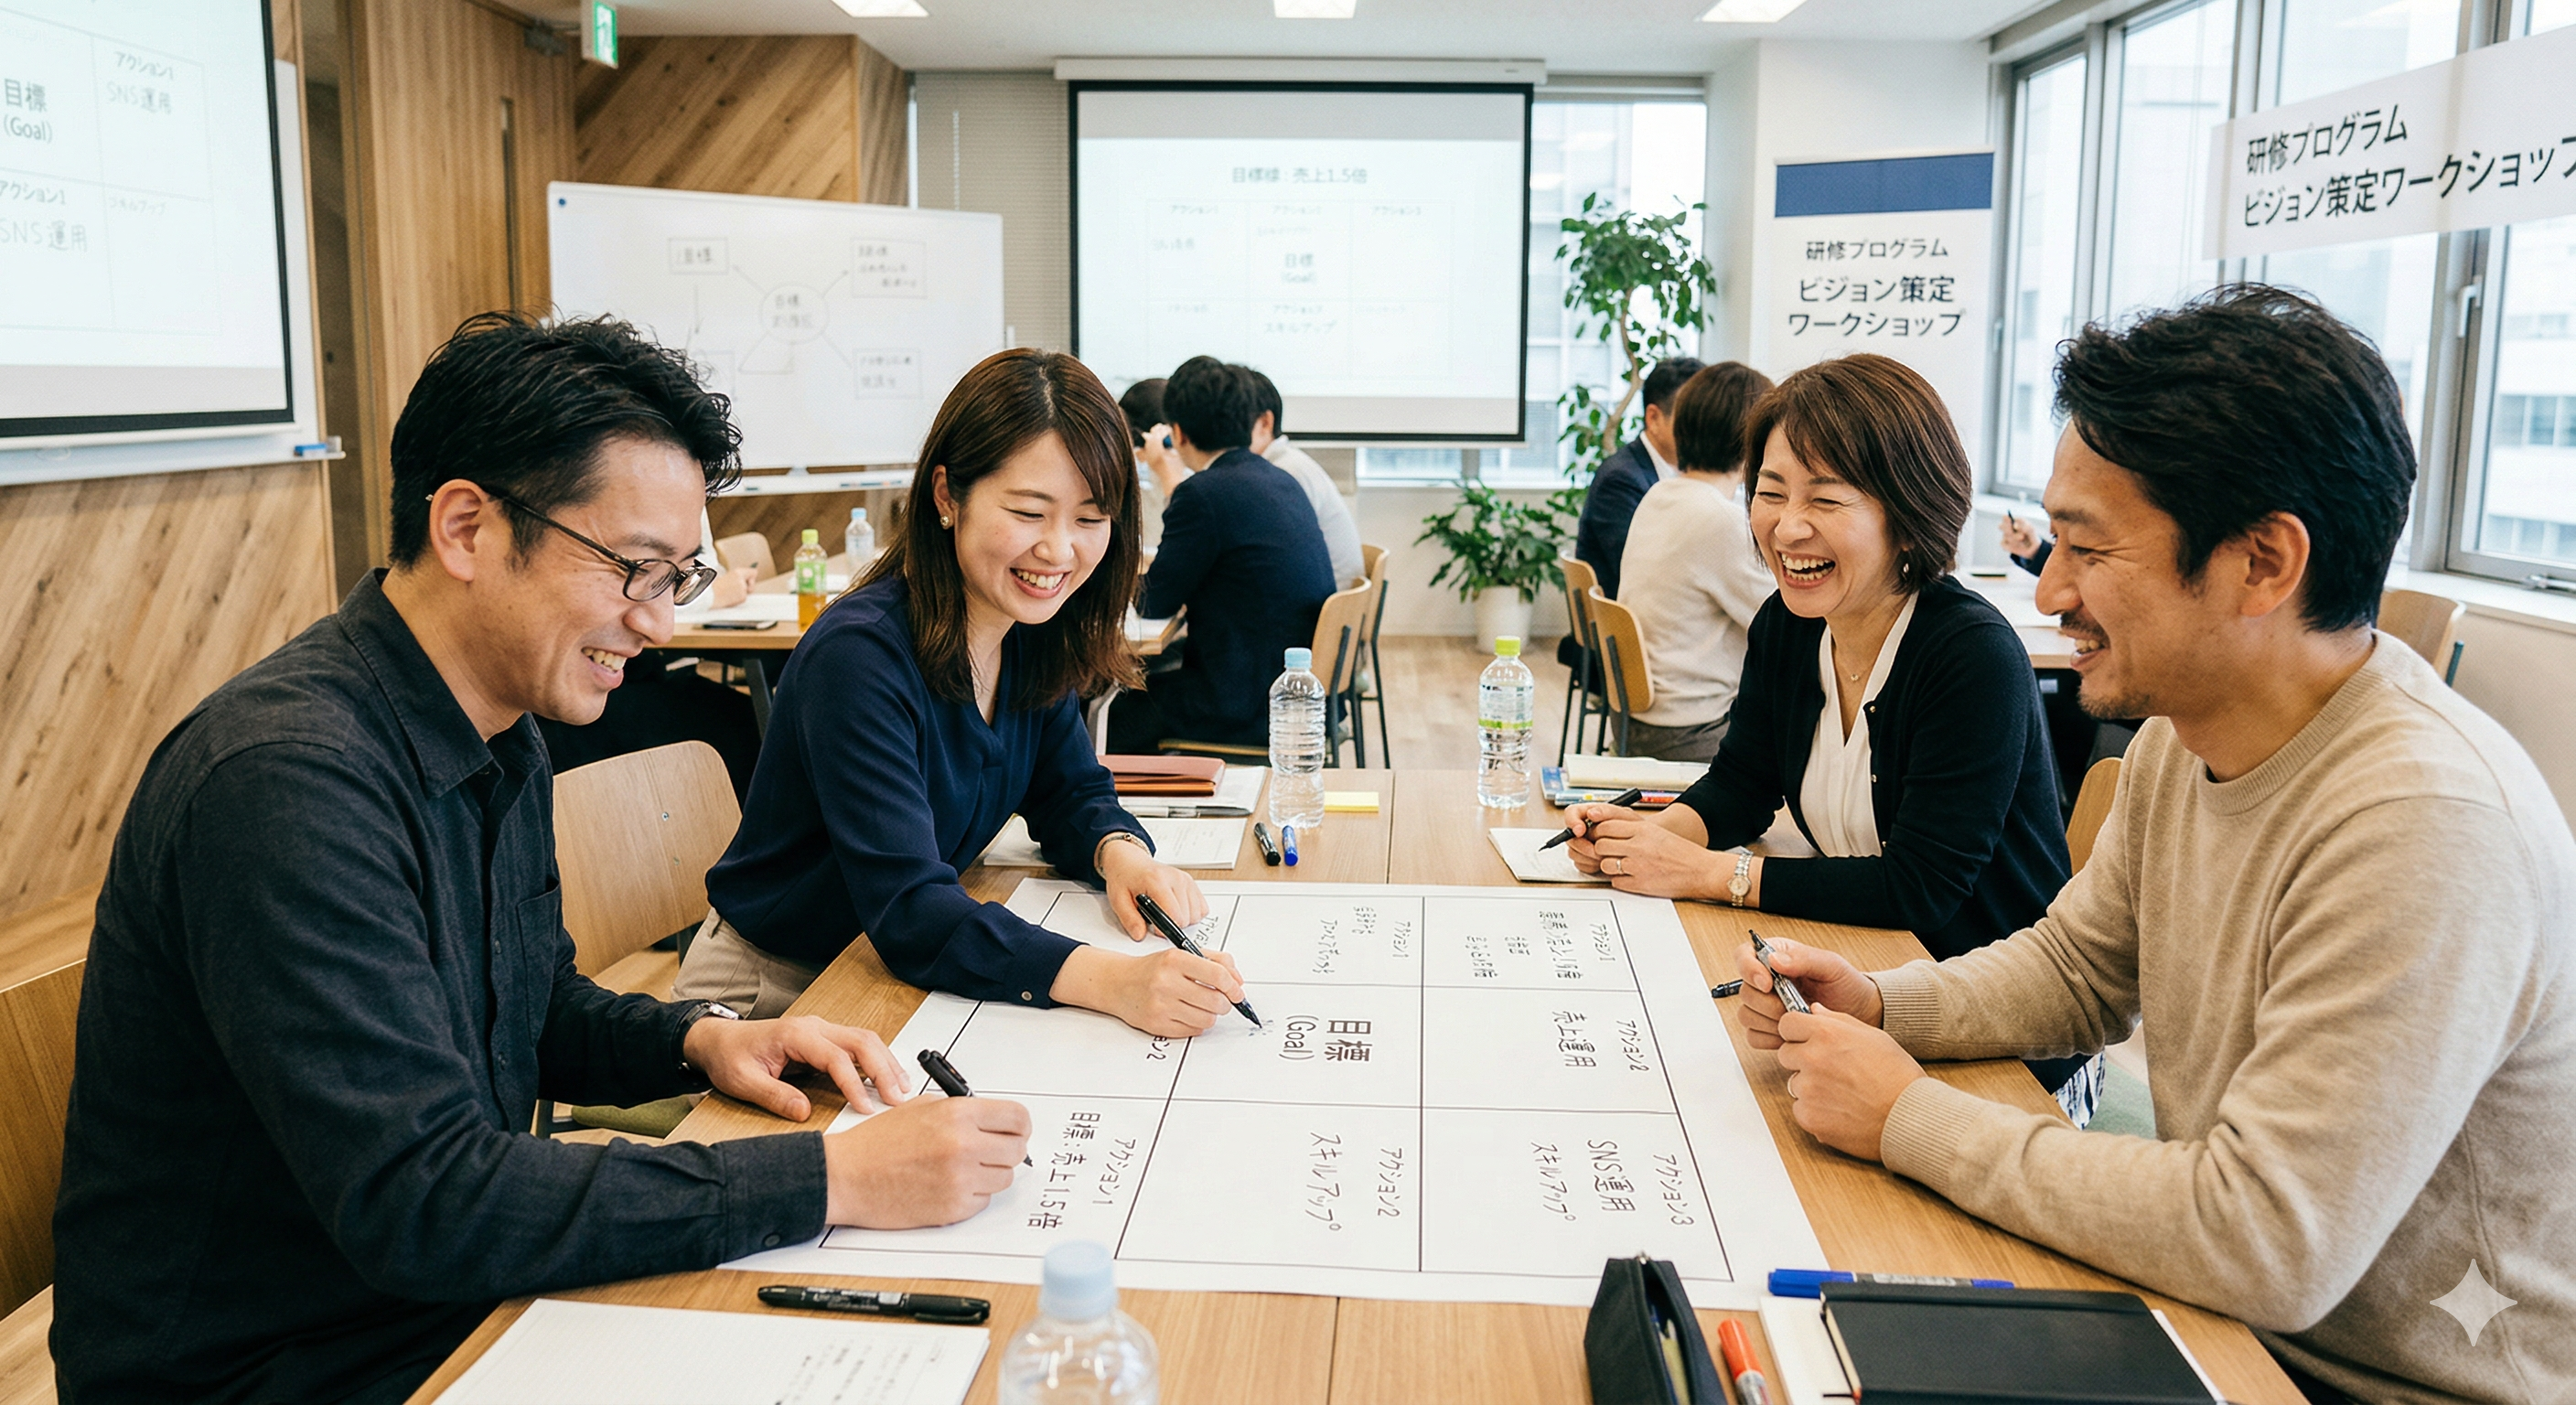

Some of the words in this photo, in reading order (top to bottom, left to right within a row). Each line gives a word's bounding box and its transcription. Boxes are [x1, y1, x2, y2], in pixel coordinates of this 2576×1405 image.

[4, 78, 48, 113] 目標
[3, 113, 53, 144] (Goal)
[2247, 103, 2408, 175] 研修プログラム
[1806, 238, 1949, 262] 研修プログラム
[1799, 275, 1956, 304] ビジョン策定
[1788, 307, 1968, 338] ワークショップ
[1278, 1014, 1320, 1061] (Goal)
[1326, 1019, 1373, 1063] 目標
[1551, 1011, 1597, 1068] 売上運用
[1091, 1138, 1137, 1207] アクション1
[1304, 1131, 1344, 1232] スキルアップ
[1378, 1147, 1404, 1218] アクション2
[1530, 1141, 1577, 1223] スキルアップ
[1587, 1139, 1637, 1212] SNS運用
[1653, 1153, 1695, 1226] アクション3
